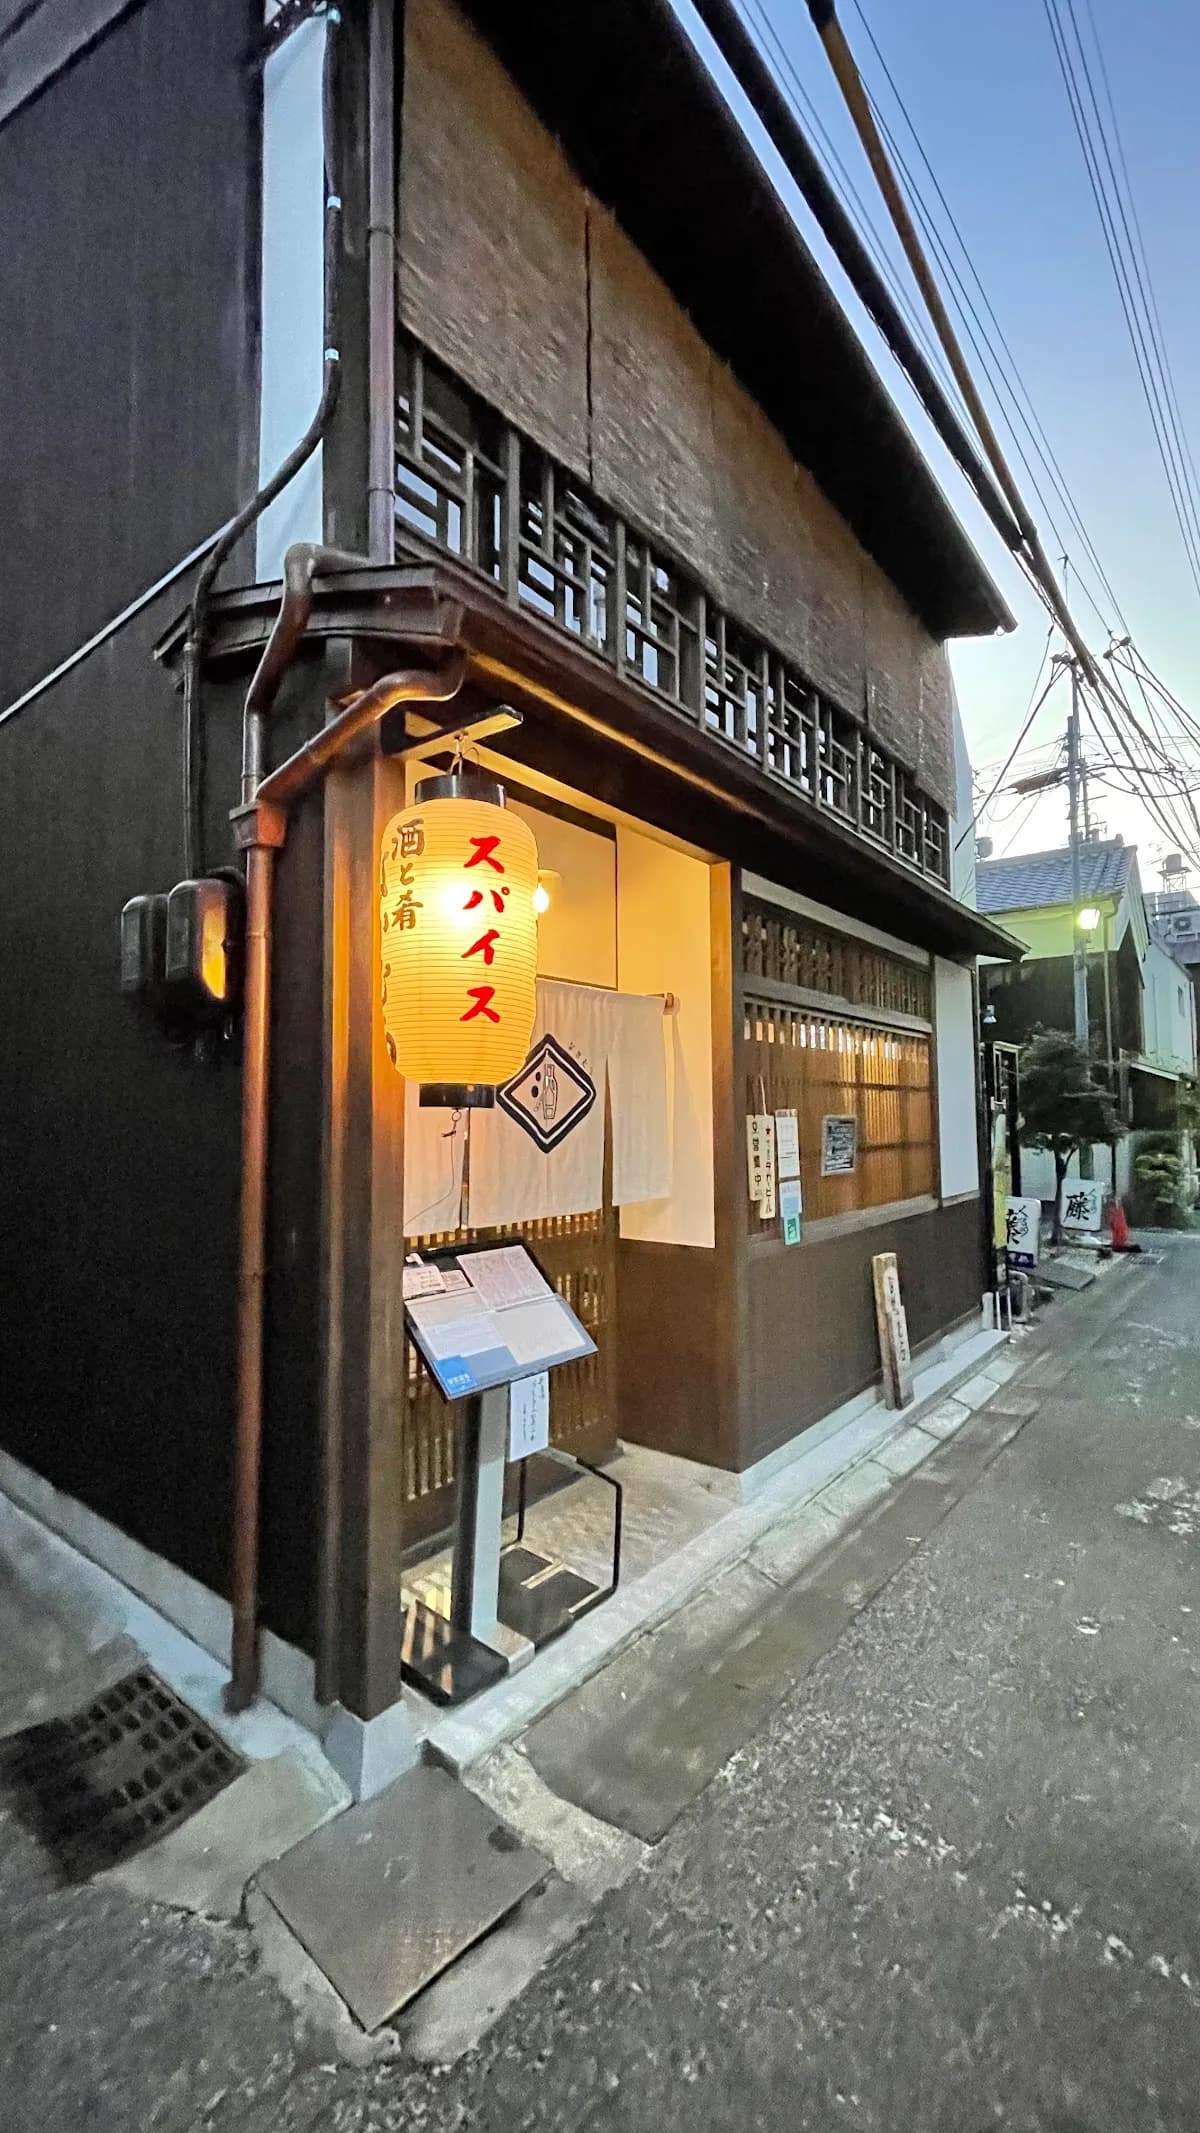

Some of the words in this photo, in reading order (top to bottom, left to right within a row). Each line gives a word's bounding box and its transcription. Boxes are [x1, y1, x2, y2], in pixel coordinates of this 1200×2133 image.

[391, 818, 425, 931] 酒と肴
[459, 835, 510, 1023] スパイス
